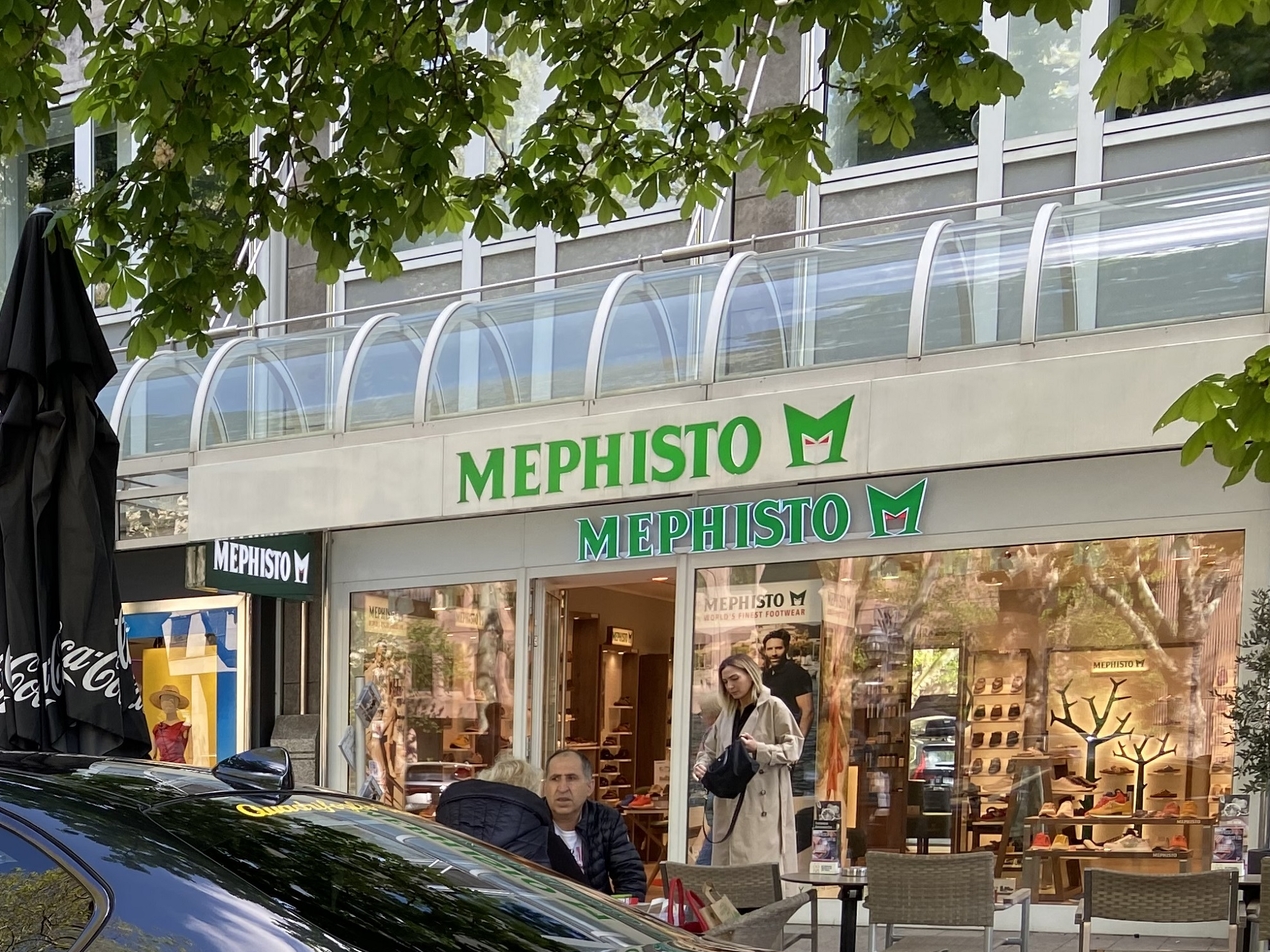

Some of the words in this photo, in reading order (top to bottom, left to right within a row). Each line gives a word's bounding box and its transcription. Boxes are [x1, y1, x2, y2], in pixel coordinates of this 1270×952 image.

[457, 415, 761, 503] MEPHISTO
[576, 493, 851, 562] MEPHISTO
[213, 539, 291, 582] MEPHISTO
[704, 593, 784, 612] MEPHISTO
[738, 611, 763, 620] FINEST
[765, 608, 806, 618] FOOTWEAR
[1093, 660, 1134, 669] MEPHISTO
